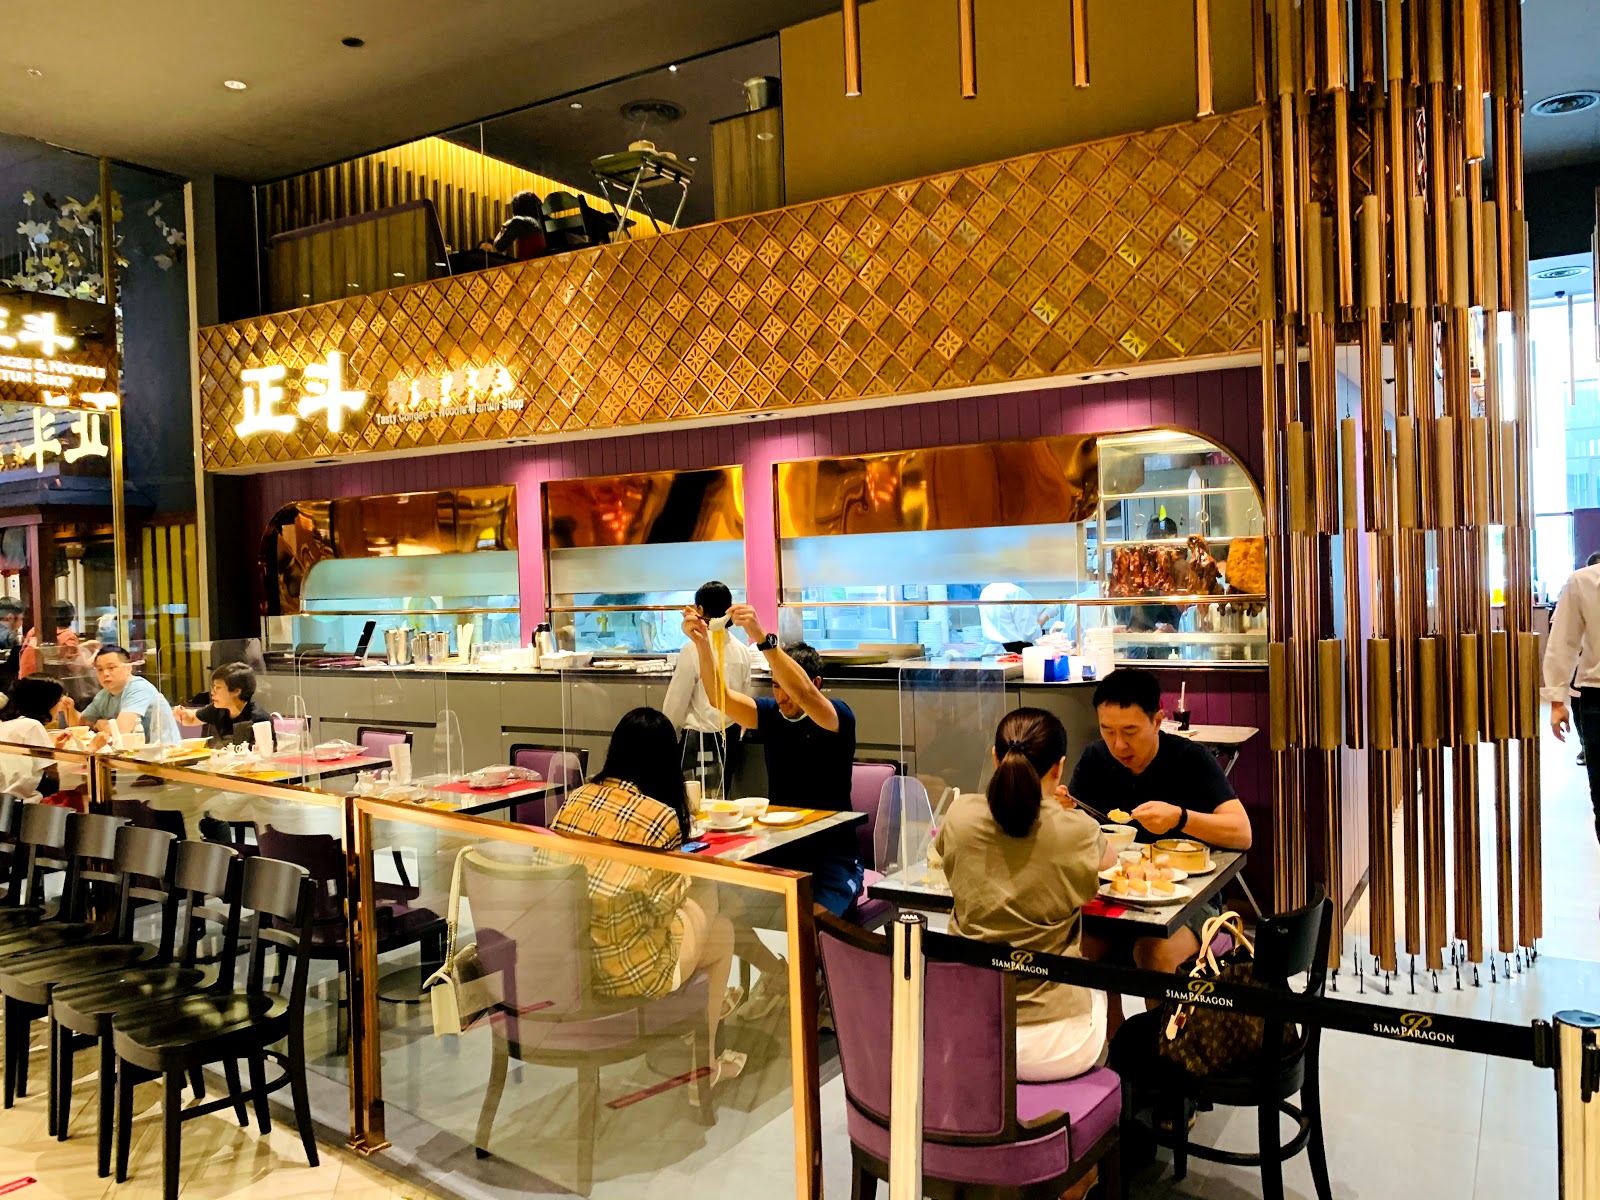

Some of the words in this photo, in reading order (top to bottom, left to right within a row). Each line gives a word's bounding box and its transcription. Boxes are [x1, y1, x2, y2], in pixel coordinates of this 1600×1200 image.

[0, 307, 75, 356] 斗
[33, 358, 48, 372] &
[49, 360, 106, 379] NOODLE
[34, 372, 73, 388] SHOP
[234, 350, 366, 438] 正斗
[376, 413, 397, 425] Tasty
[502, 397, 524, 412] Shop
[991, 957, 1049, 976] SIAMPARAGON
[1165, 988, 1234, 1007] SIAMPARAGON
[1373, 1022, 1455, 1043] SIAMPARAGON
